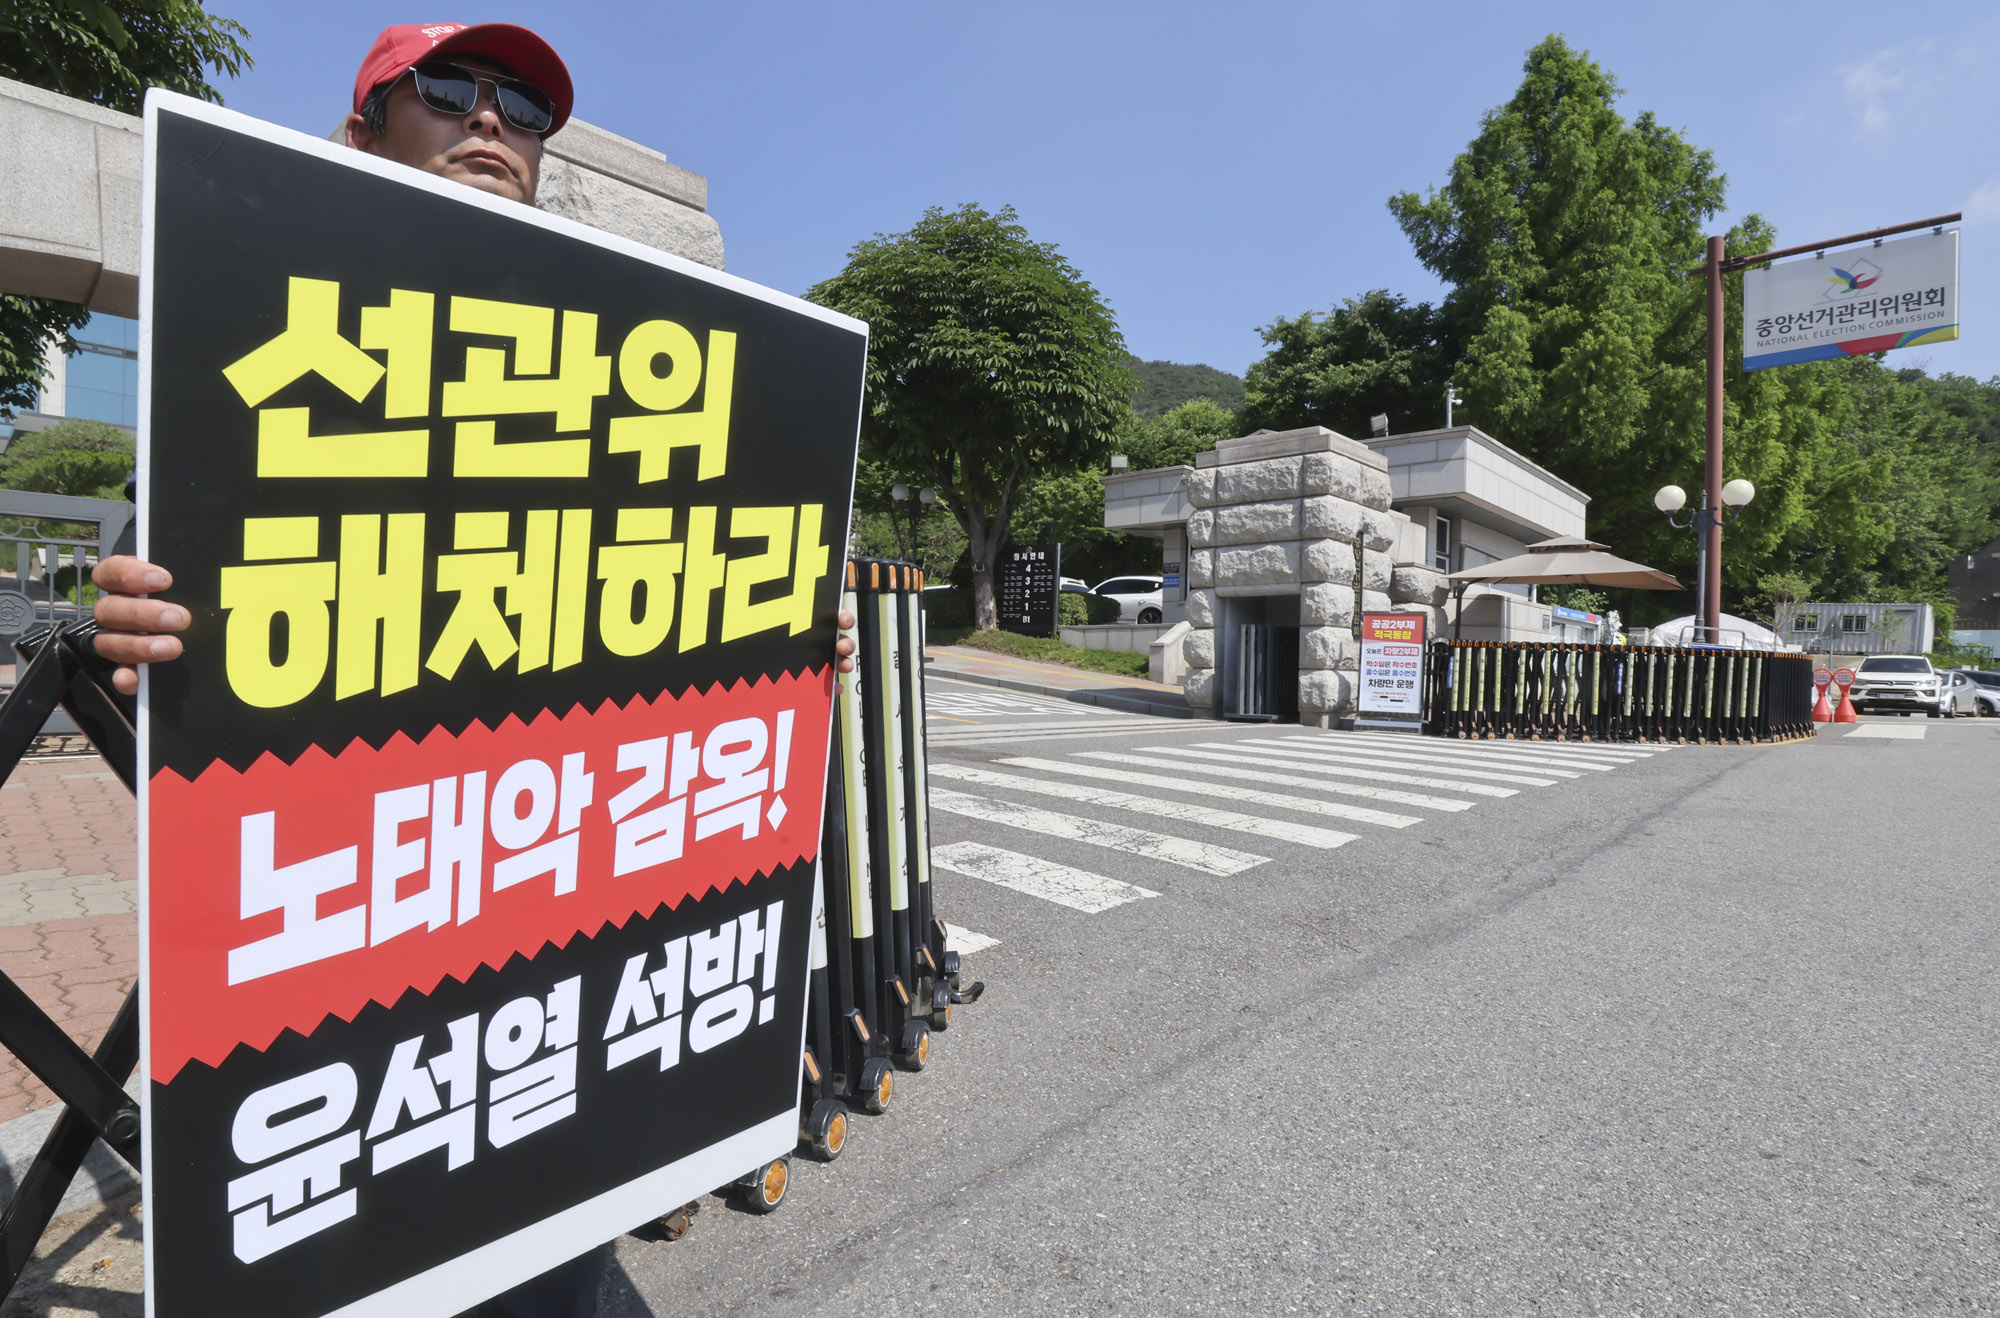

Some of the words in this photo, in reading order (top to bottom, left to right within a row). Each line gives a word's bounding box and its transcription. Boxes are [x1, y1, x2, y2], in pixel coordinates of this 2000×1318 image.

[421, 26, 455, 38] STOP
[1755, 286, 1946, 338] 중앙선거관리위원회
[1756, 333, 1809, 348] NATIONAL
[1813, 323, 1866, 338] ELECTION
[1869, 310, 1945, 330] COMMISSION
[222, 276, 737, 485] 선관위
[1025, 564, 1031, 572] 4
[1025, 577, 1031, 585] 3
[1025, 590, 1030, 598] 2
[219, 503, 829, 708] 해체하라
[1024, 602, 1028, 611] 1
[1371, 619, 1416, 630] 공공2부제
[1374, 629, 1412, 640] 적극동참
[1384, 647, 1418, 656] 차량2부제
[1368, 678, 1394, 688] 차량만
[1396, 679, 1414, 689] 운행
[227, 750, 594, 986] 노태악
[608, 708, 796, 879] 감옥!
[226, 974, 583, 1265] 윤석열
[602, 899, 784, 1073] 석방!
